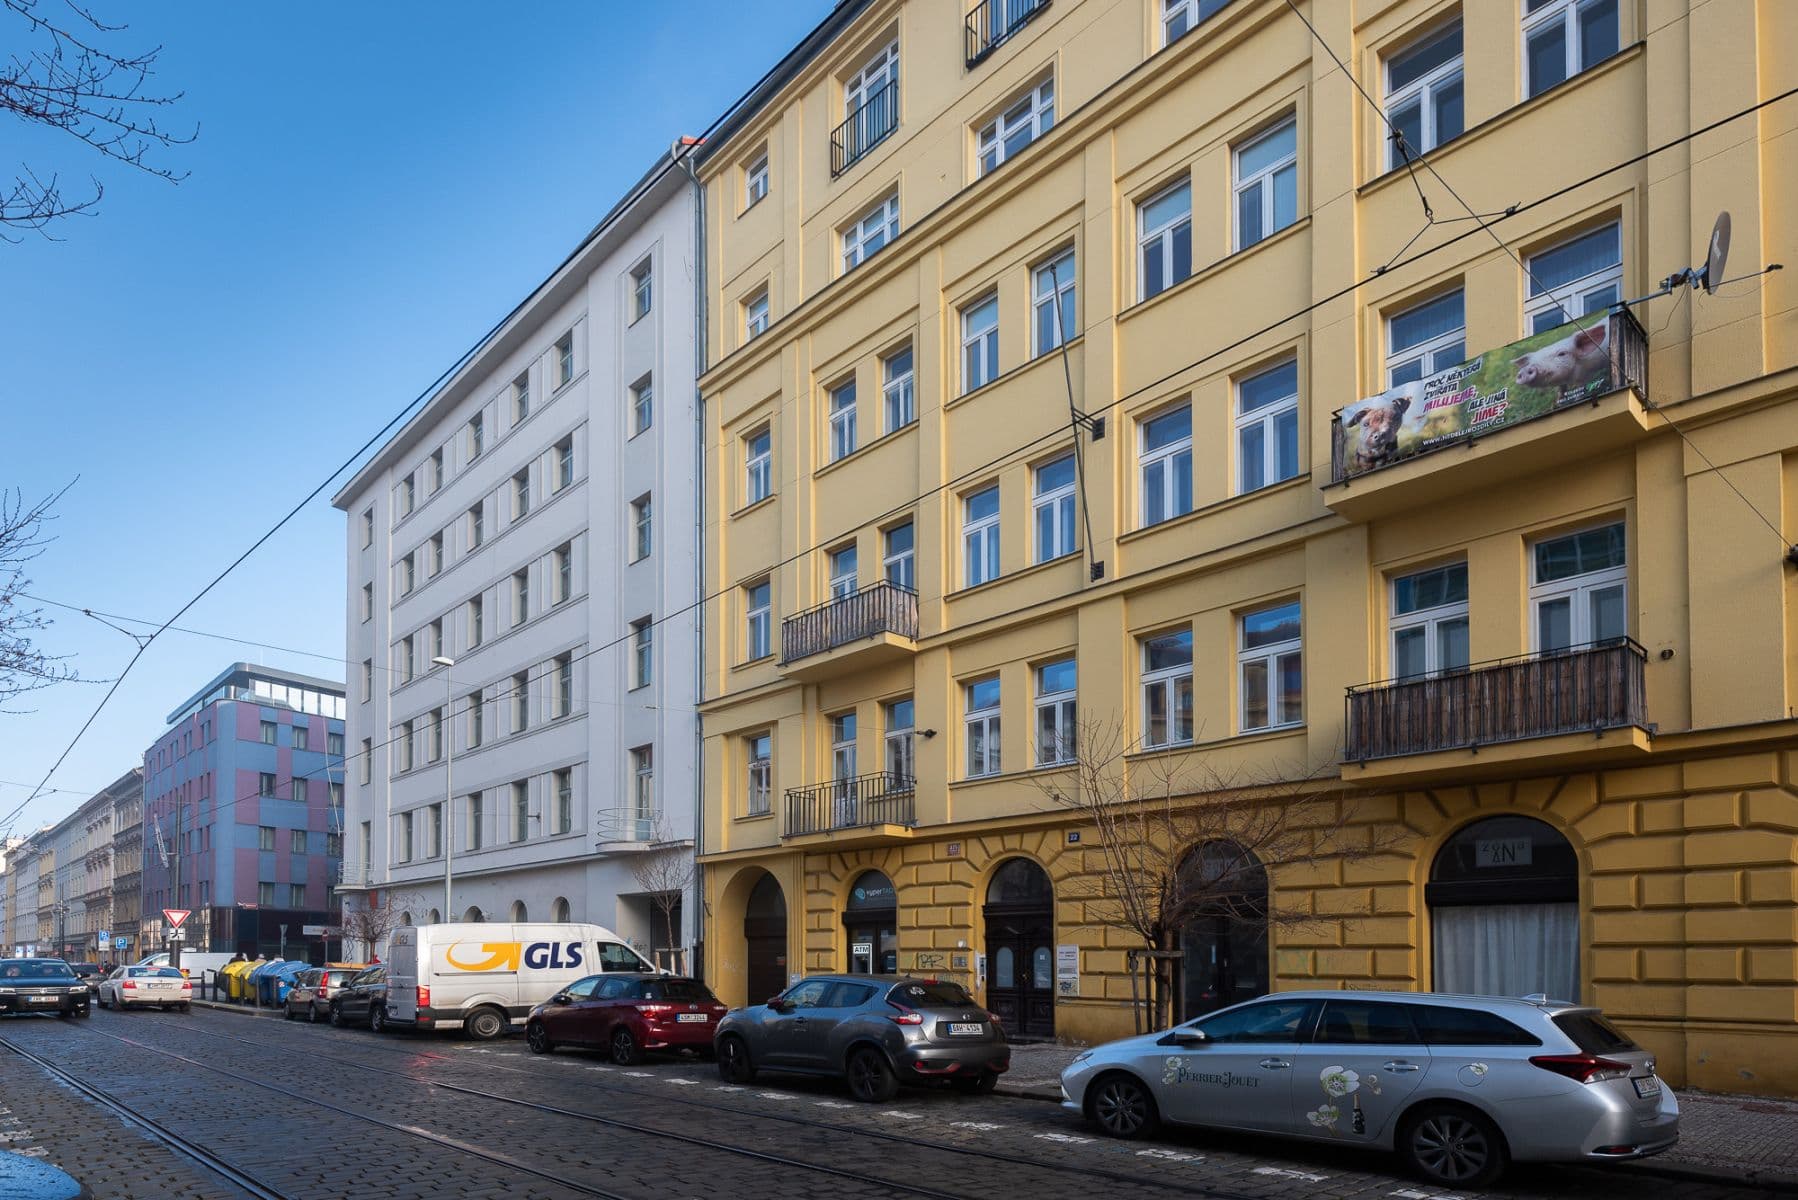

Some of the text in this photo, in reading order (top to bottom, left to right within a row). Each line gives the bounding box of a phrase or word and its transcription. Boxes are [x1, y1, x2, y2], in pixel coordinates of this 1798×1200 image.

[1423, 387, 1477, 413] MILUJEME,
[1469, 397, 1486, 411] ALE
[524, 942, 582, 969] GLS
